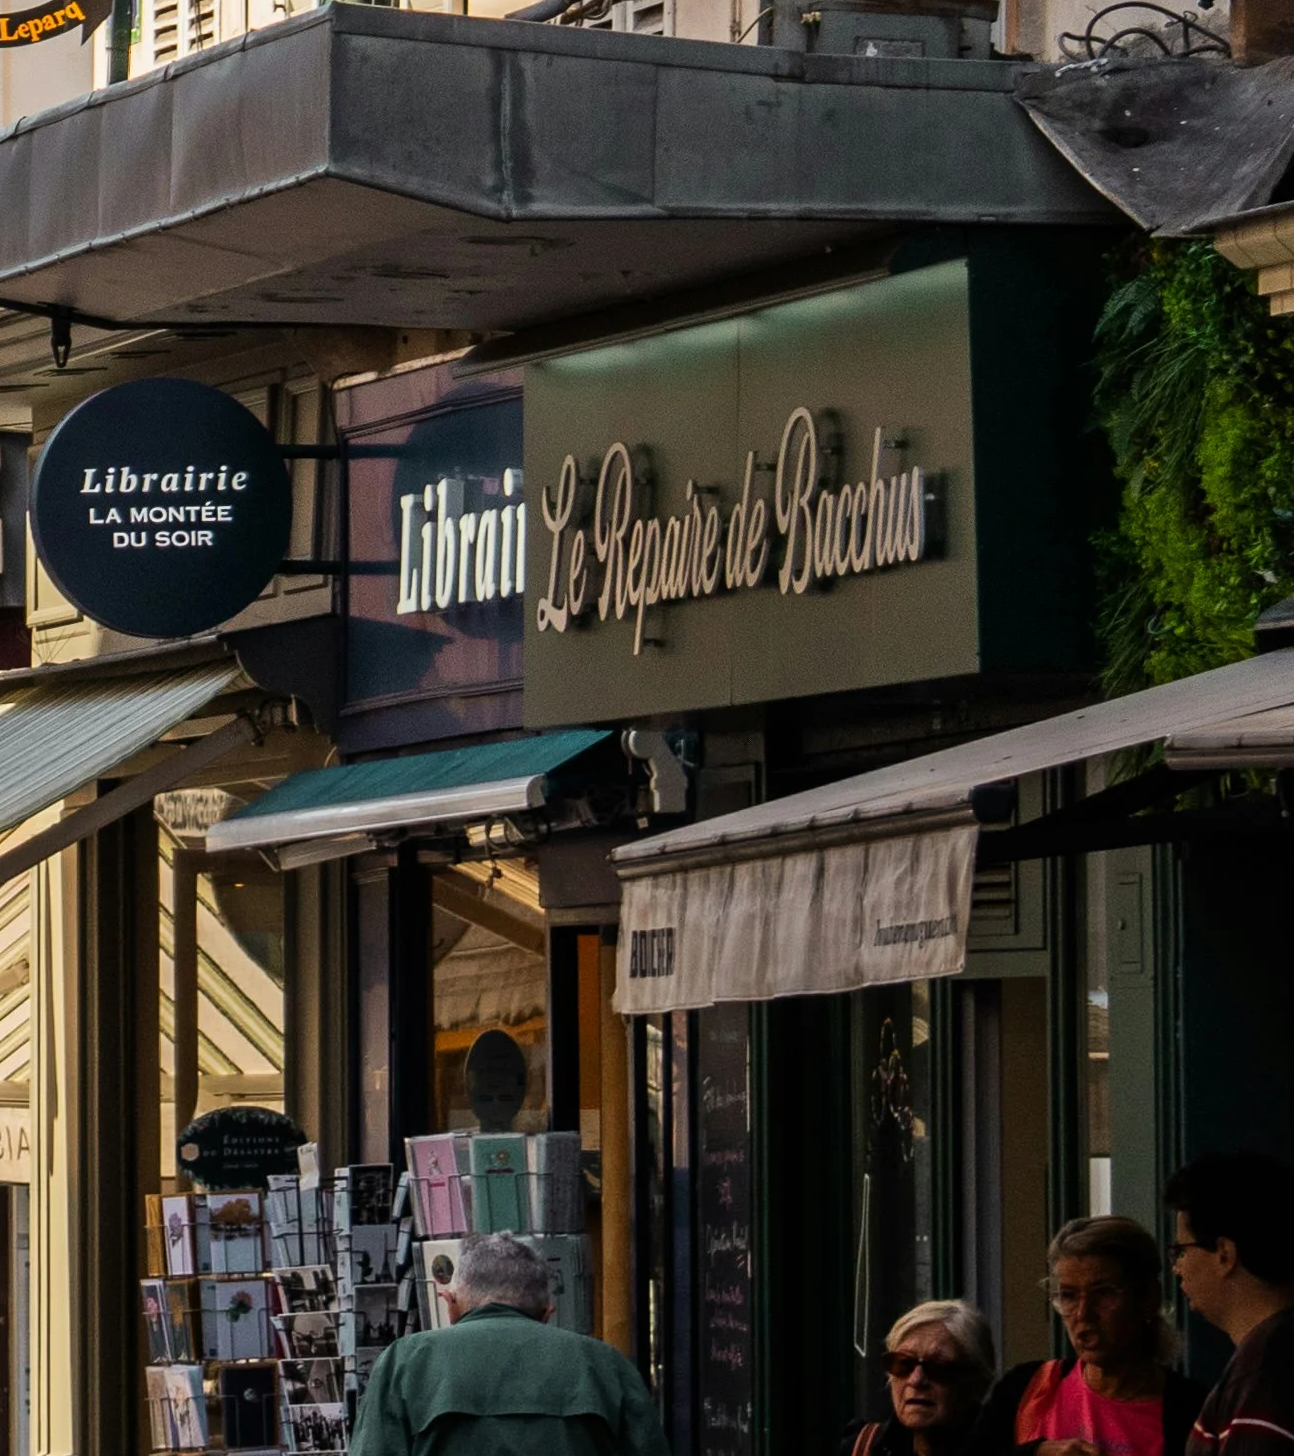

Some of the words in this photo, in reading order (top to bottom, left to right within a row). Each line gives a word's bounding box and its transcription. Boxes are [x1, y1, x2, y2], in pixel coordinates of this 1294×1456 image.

[80, 465, 249, 494] Librairie
[89, 506, 122, 525] LA
[130, 500, 233, 524] MONTÉE
[112, 531, 146, 549] DU
[154, 529, 214, 548] SOIR
[536, 453, 586, 633] Le
[593, 442, 722, 656] Repaire
[724, 450, 767, 590] de
[775, 406, 925, 596] Bacchus
